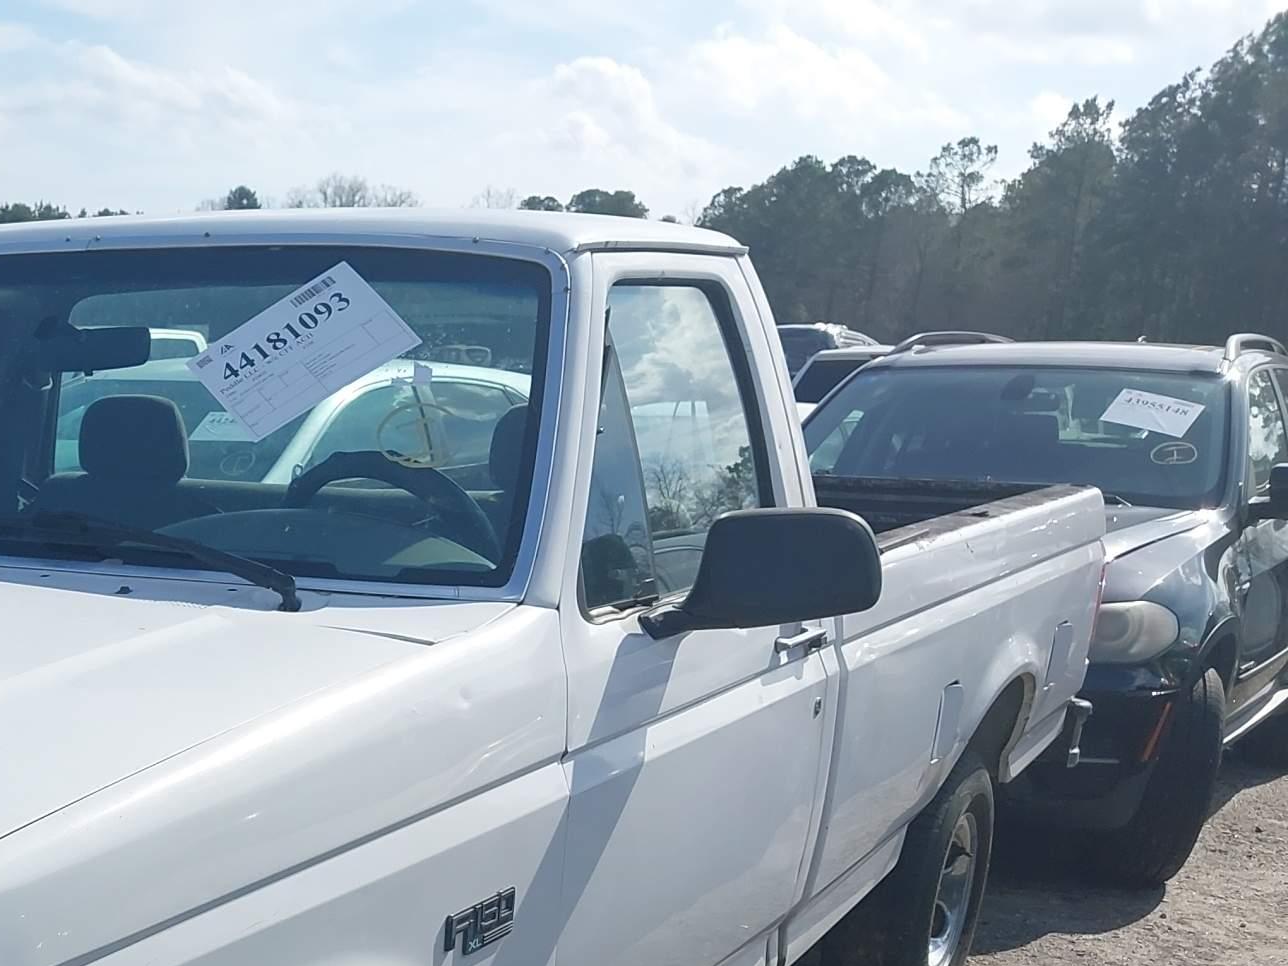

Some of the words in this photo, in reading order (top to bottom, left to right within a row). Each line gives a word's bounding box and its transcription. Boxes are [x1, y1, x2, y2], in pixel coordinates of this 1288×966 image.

[222, 291, 351, 380] 44181093
[444, 886, 516, 955] F150
[468, 937, 483, 952] XL
